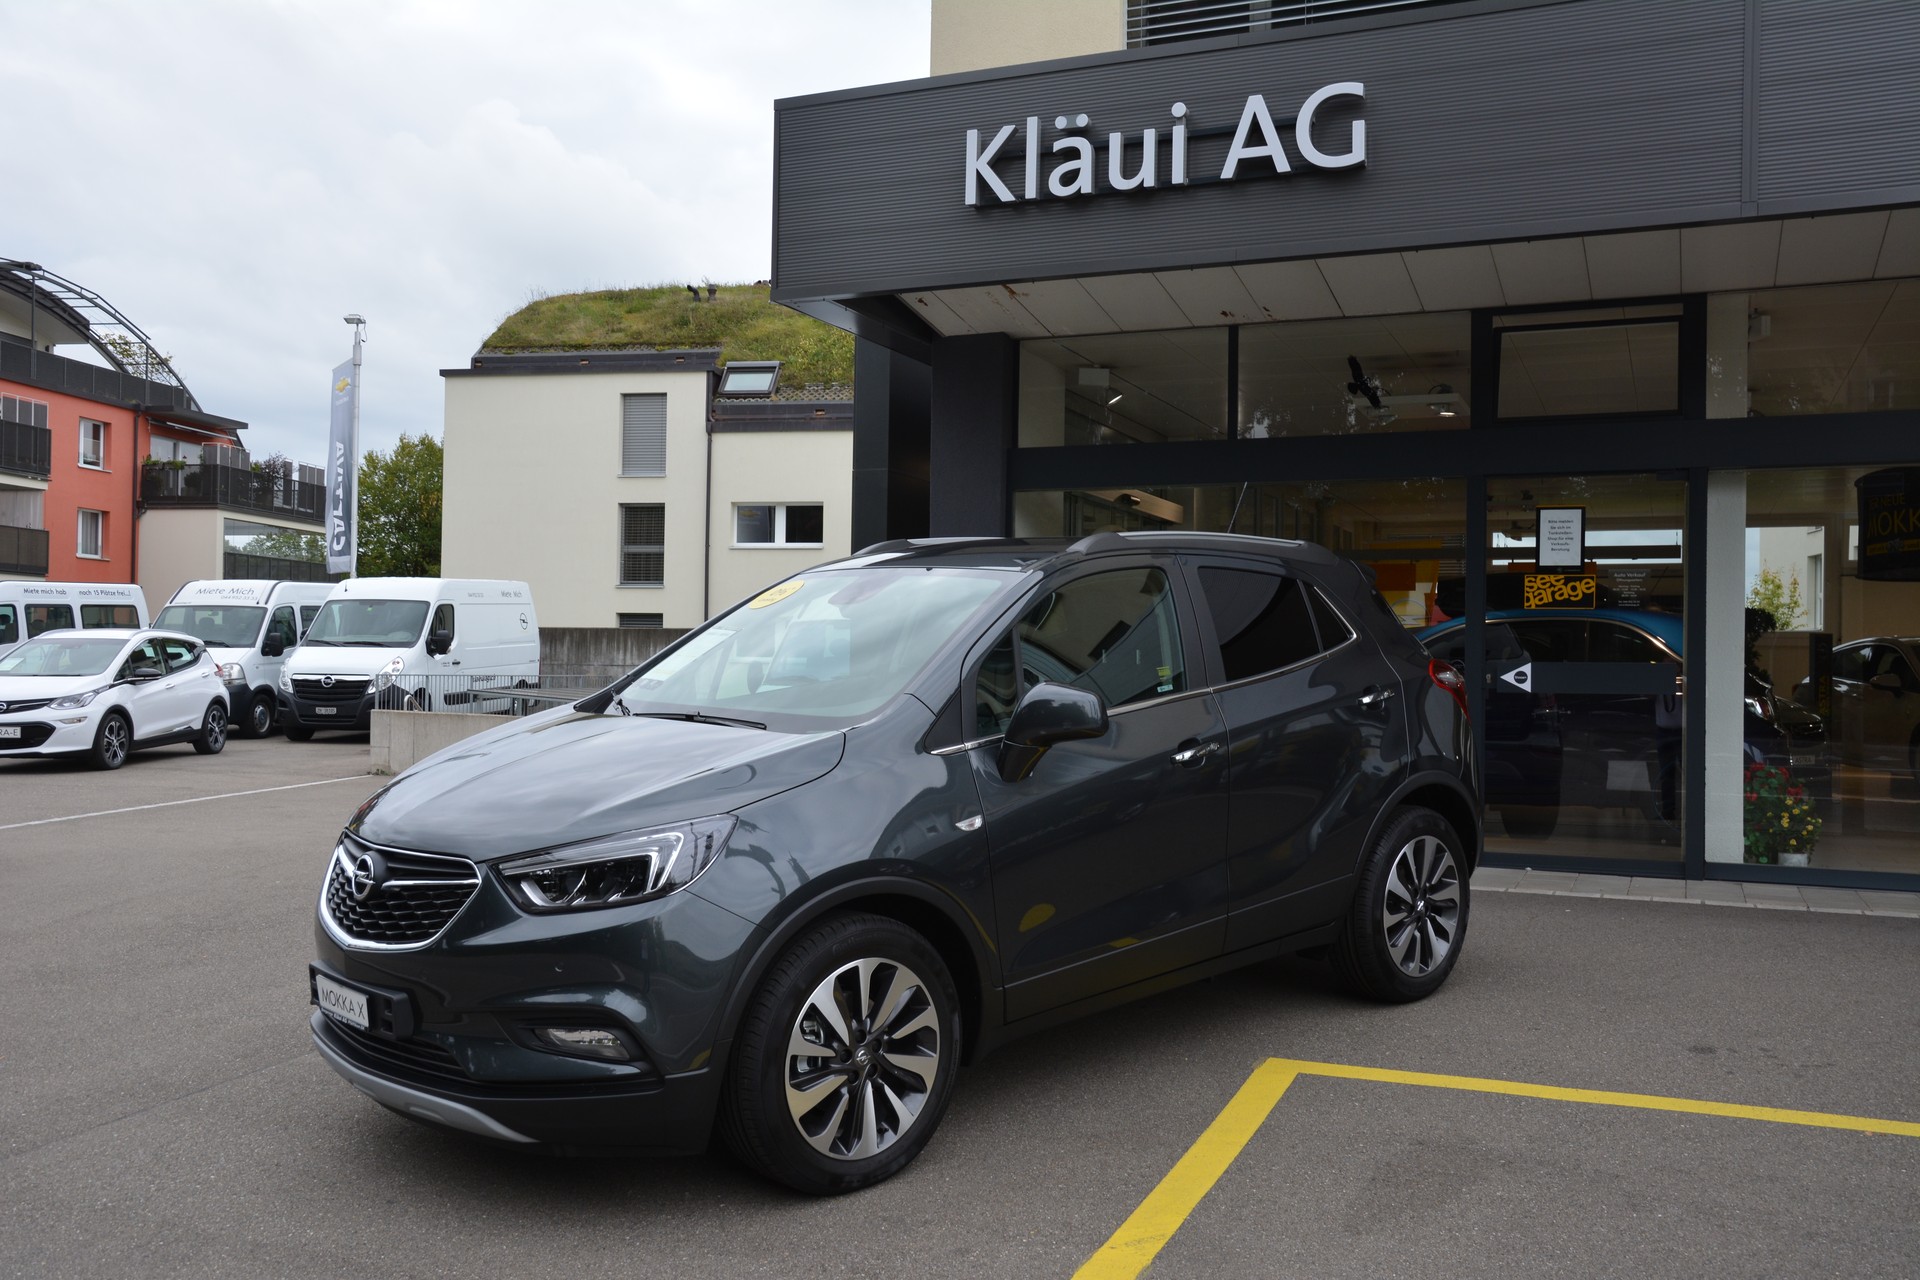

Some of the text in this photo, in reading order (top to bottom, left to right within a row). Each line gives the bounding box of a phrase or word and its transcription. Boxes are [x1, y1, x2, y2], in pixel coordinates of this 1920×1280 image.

[964, 81, 1367, 206] Kläui AG
[23, 587, 67, 596] Miete mich hab
[79, 588, 92, 596] noch
[195, 587, 255, 595] Miete Mich
[1525, 575, 1565, 592] see
[1525, 578, 1595, 608] garage
[321, 987, 356, 1016] MOKKA
[357, 1001, 366, 1020] X
